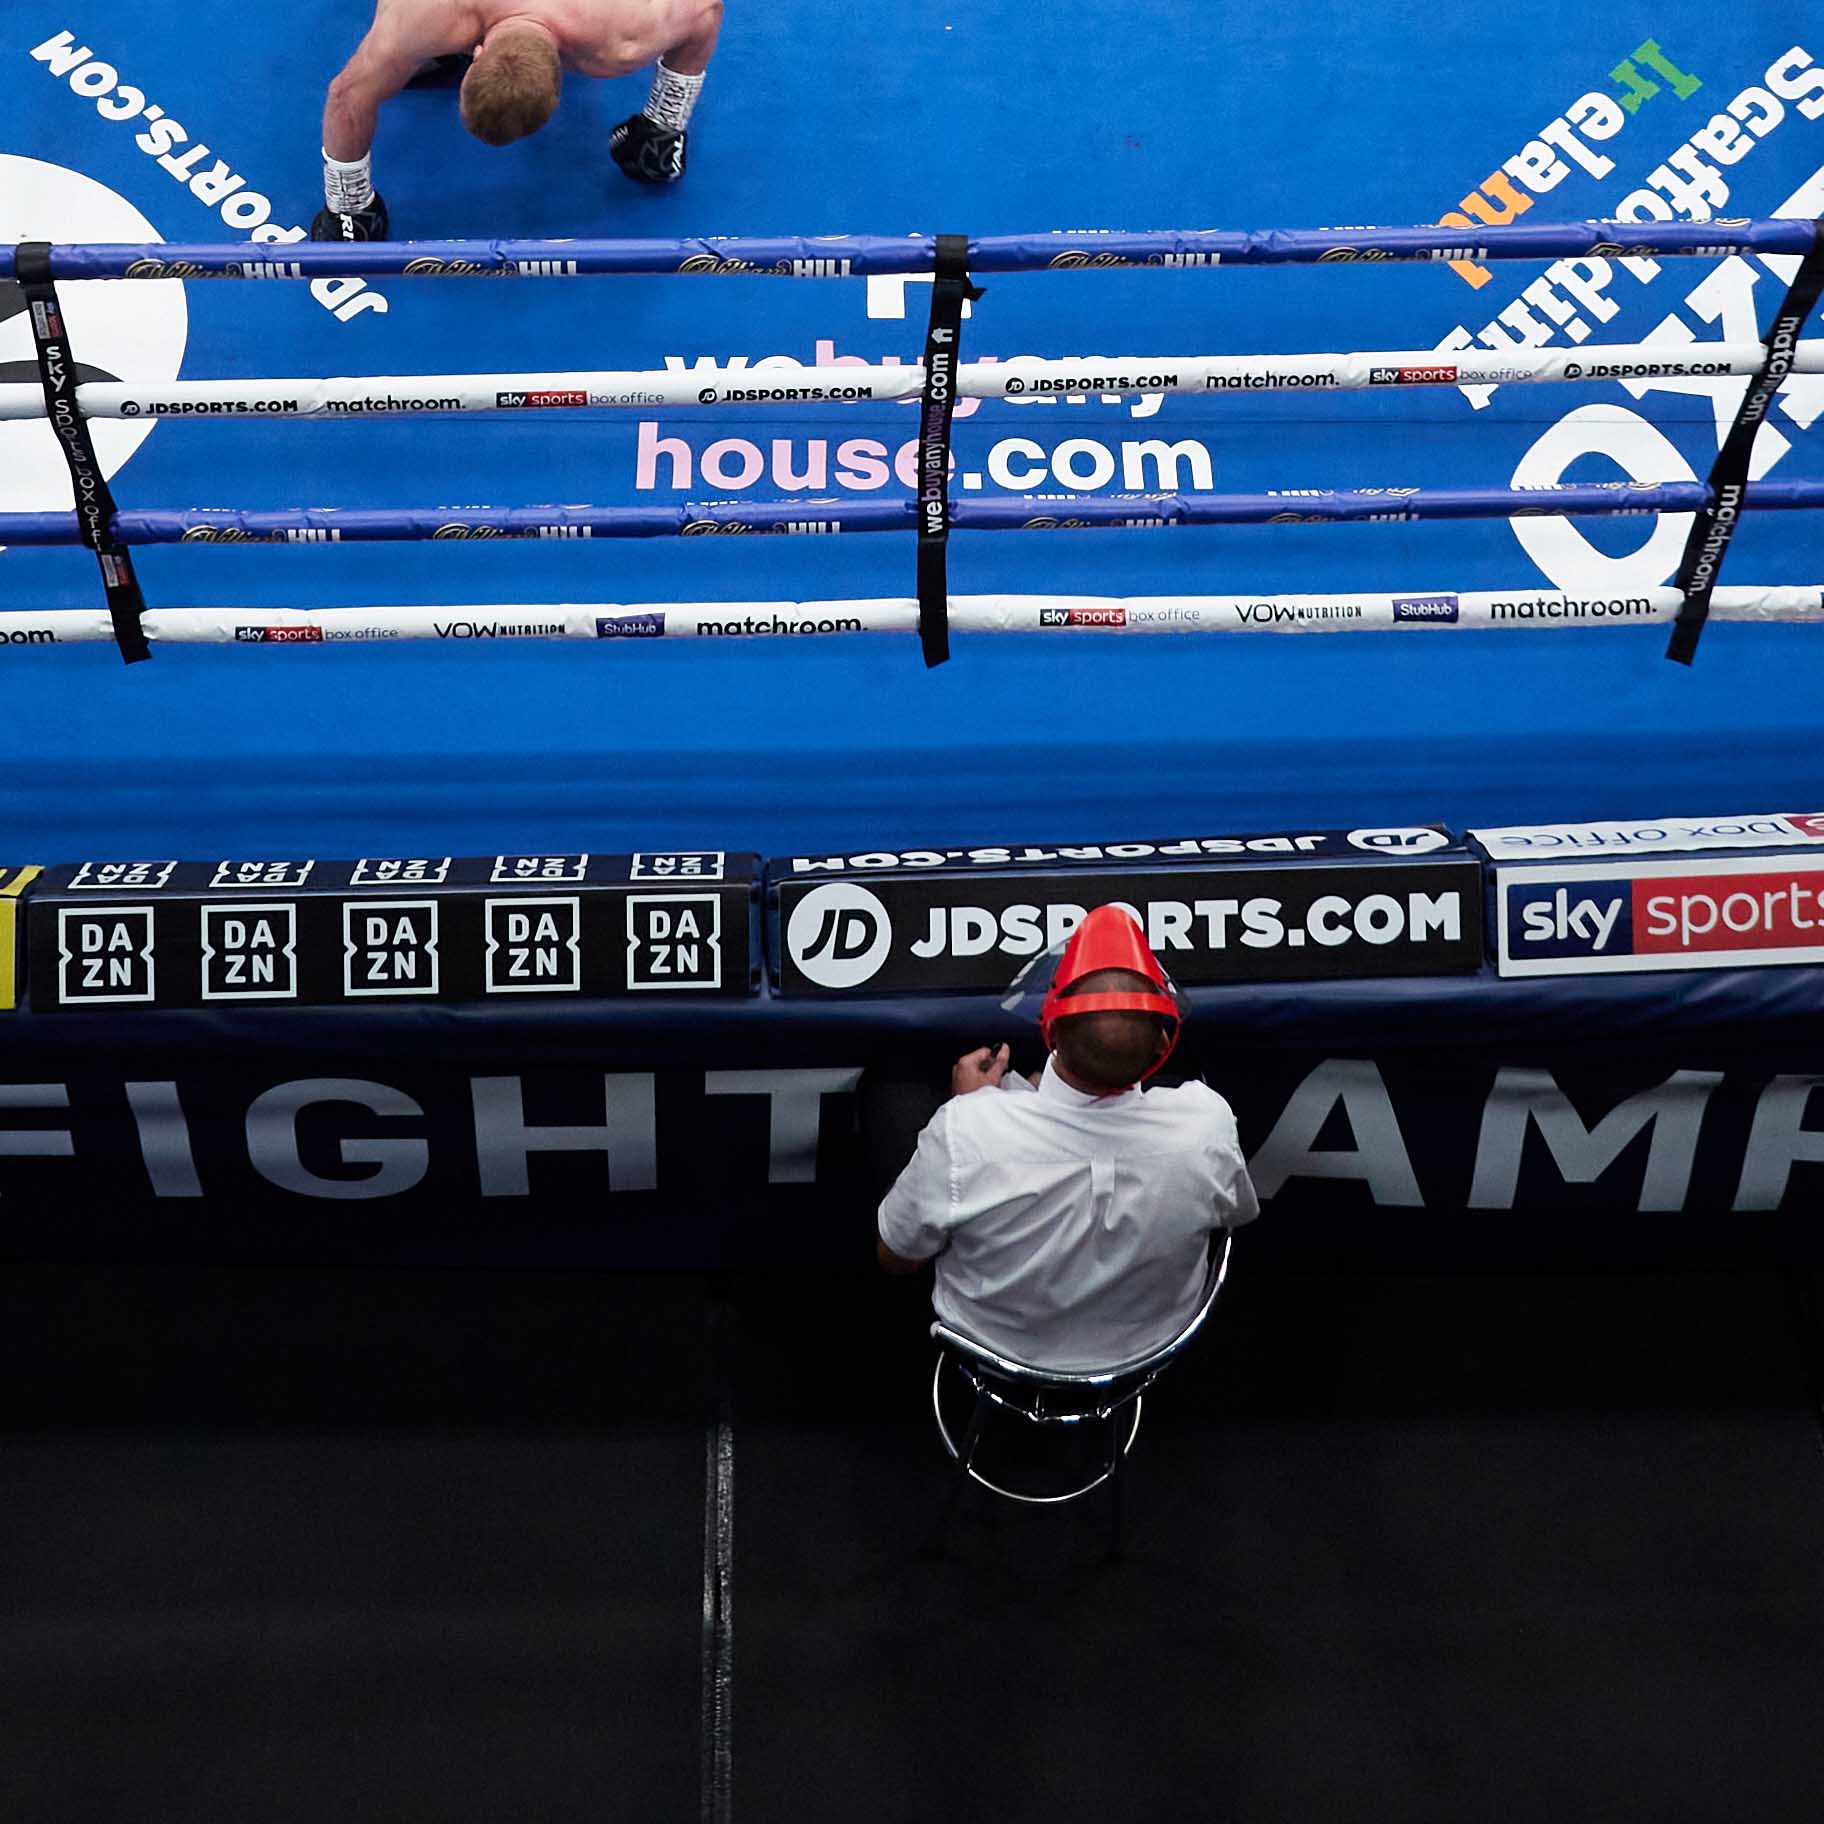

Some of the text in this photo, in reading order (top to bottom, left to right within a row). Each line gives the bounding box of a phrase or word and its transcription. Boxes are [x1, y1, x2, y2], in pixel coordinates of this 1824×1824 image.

[28, 30, 390, 323] JDPORTS.COM
[144, 394, 467, 415] JDSPORTS.COM matchroom.
[924, 352, 952, 534] webuyanyhouse.com
[1687, 484, 1742, 598] matchroom.
[696, 613, 869, 636] matchroom.
[1399, 595, 1659, 619] StubHub matchroom.
[791, 834, 1328, 874] JDSPORTS.COM
[800, 890, 1462, 961] JD JDSPRTS.COM
[1520, 886, 1625, 952] sky
